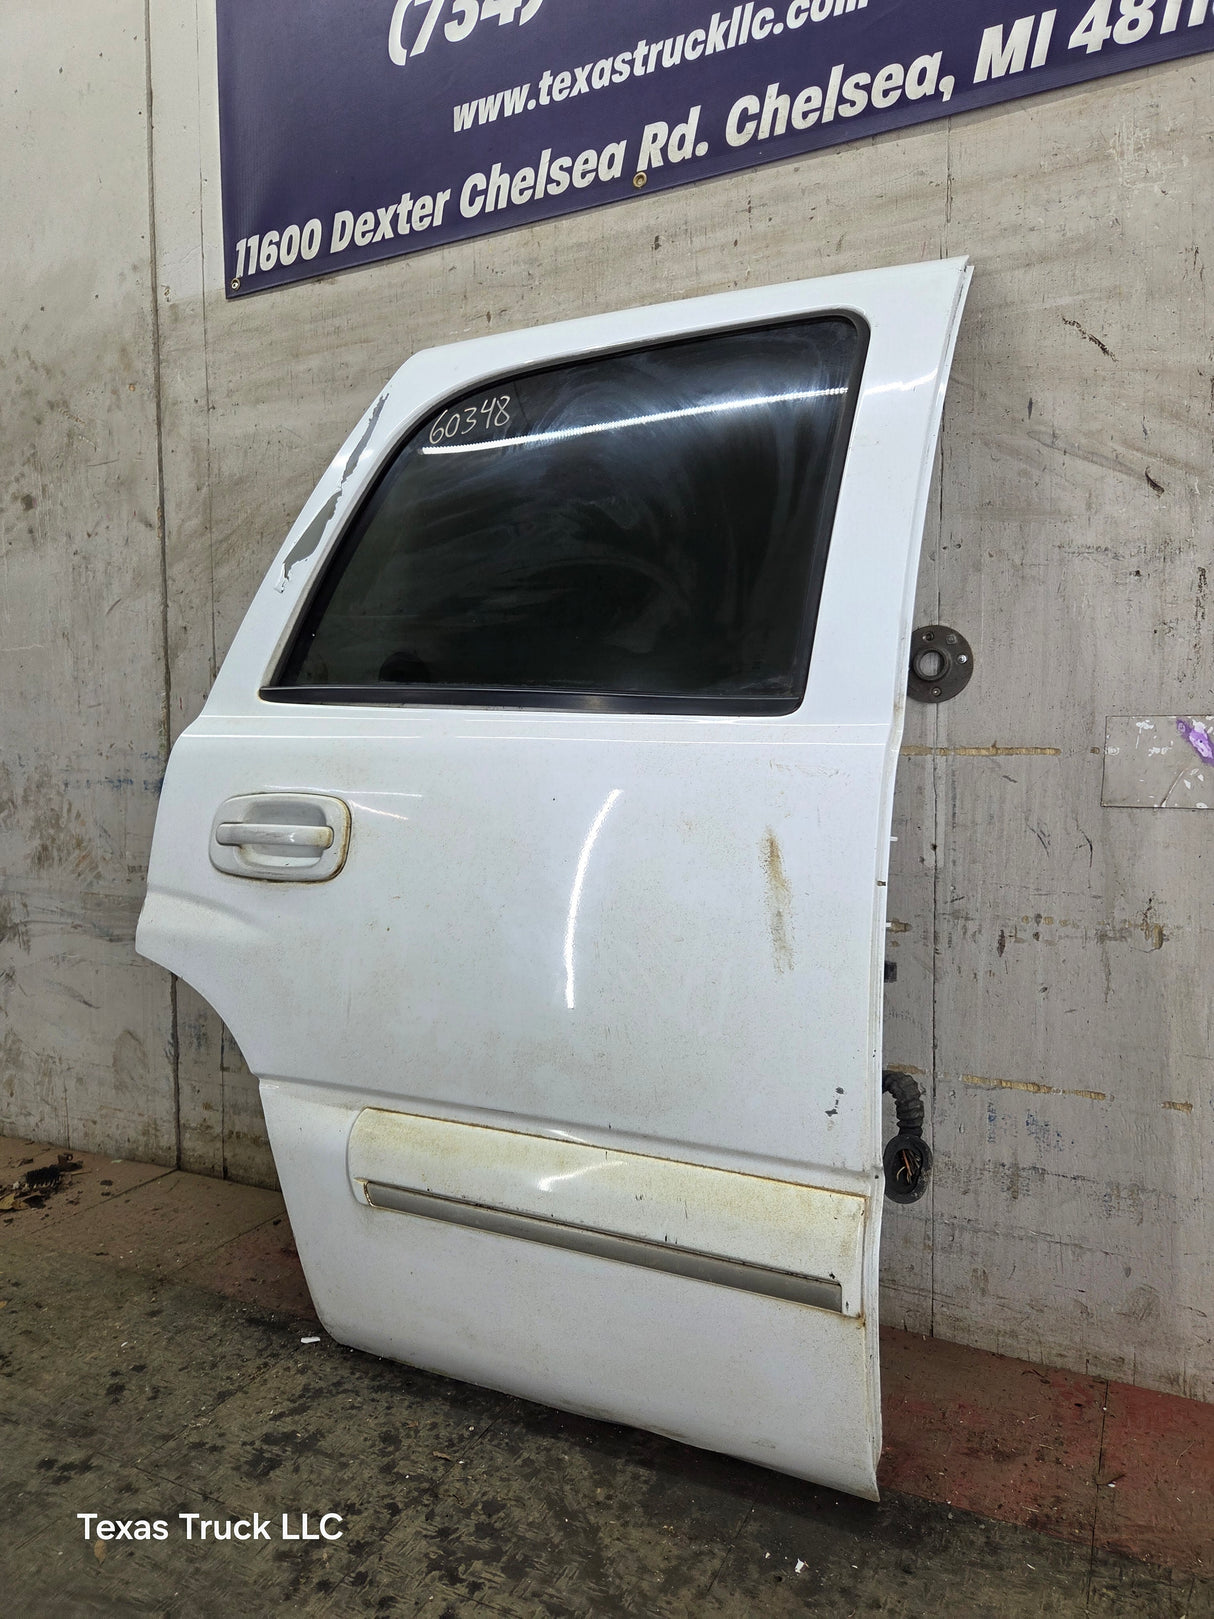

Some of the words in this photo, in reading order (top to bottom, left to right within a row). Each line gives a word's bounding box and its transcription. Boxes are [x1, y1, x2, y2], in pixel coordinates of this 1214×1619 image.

[388, 0, 544, 66] (73
[234, 219, 322, 279] 11600
[329, 188, 451, 254] Dexter
[459, 139, 628, 219] Chelsea
[636, 104, 709, 173] Rd.
[725, 50, 955, 147] Chelsea,
[972, 8, 1057, 84] MI
[429, 395, 511, 445] 60348
